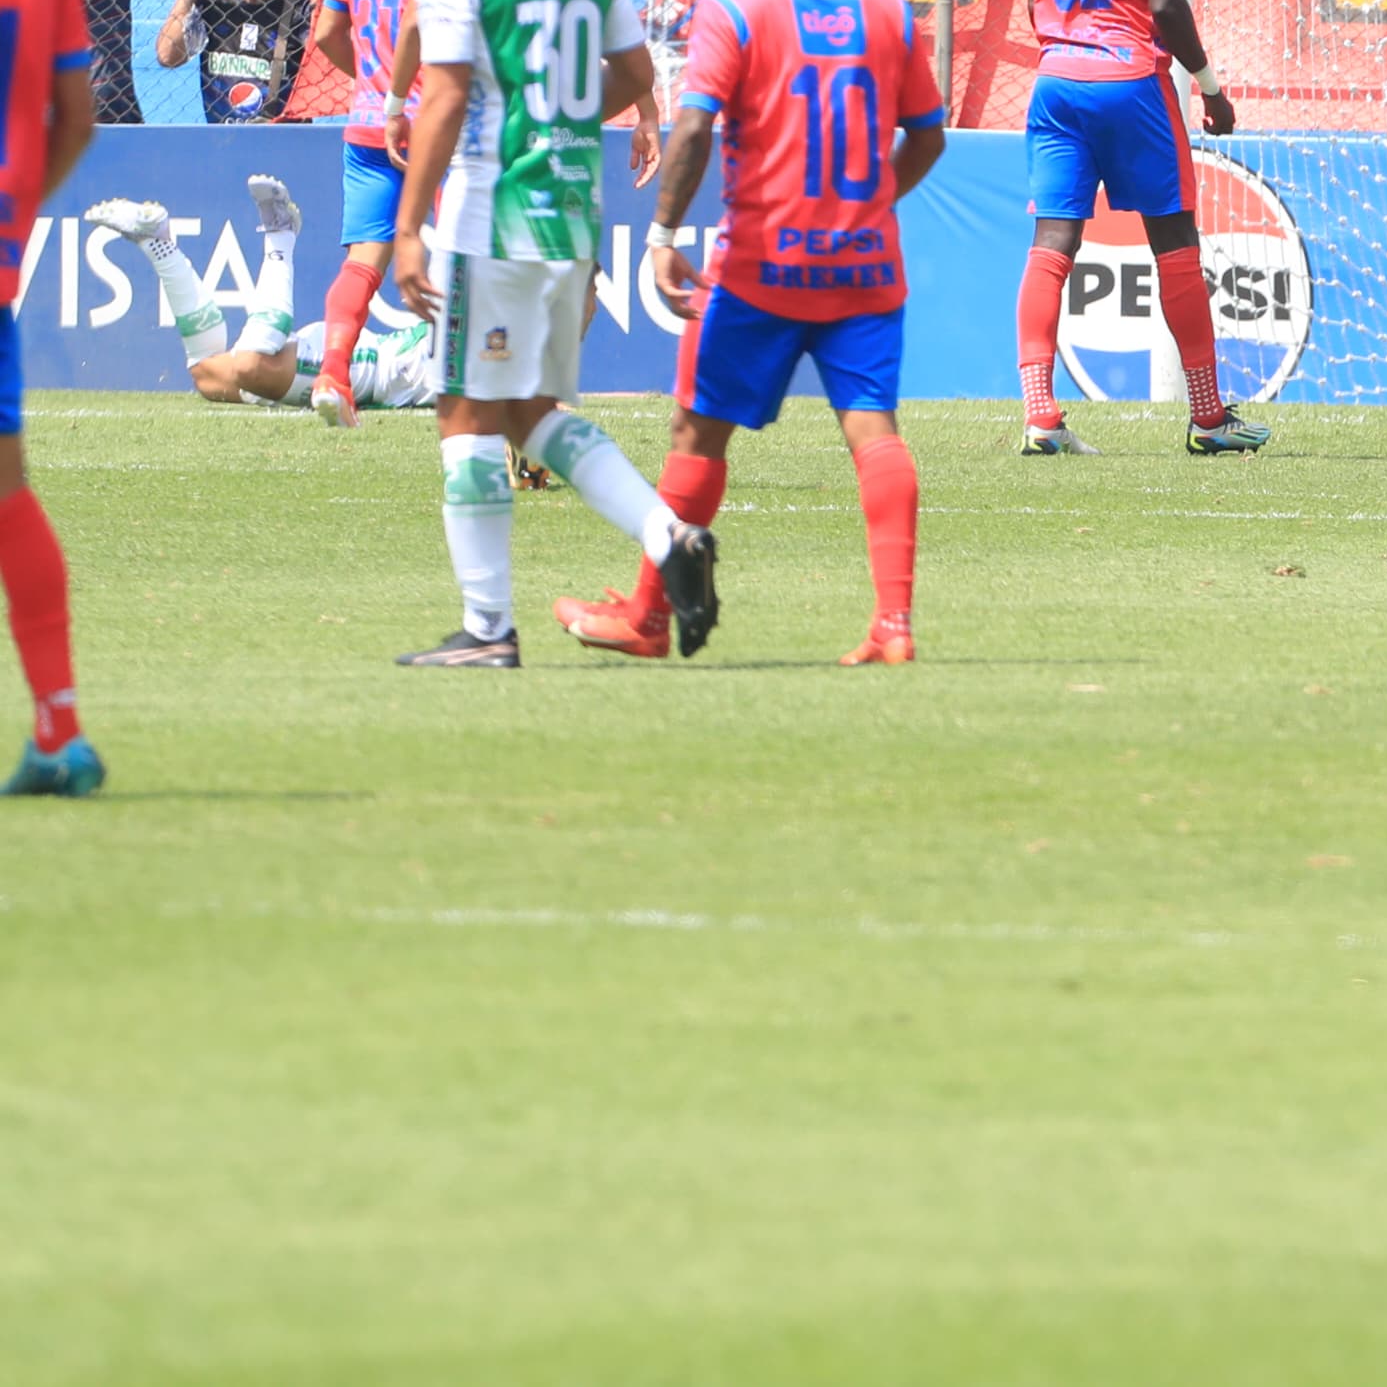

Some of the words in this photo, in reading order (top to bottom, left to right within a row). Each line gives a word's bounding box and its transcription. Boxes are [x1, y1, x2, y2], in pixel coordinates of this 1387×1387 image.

[790, 64, 882, 203] 10
[777, 227, 886, 257] PEPSI
[758, 262, 898, 290] BREMEN
